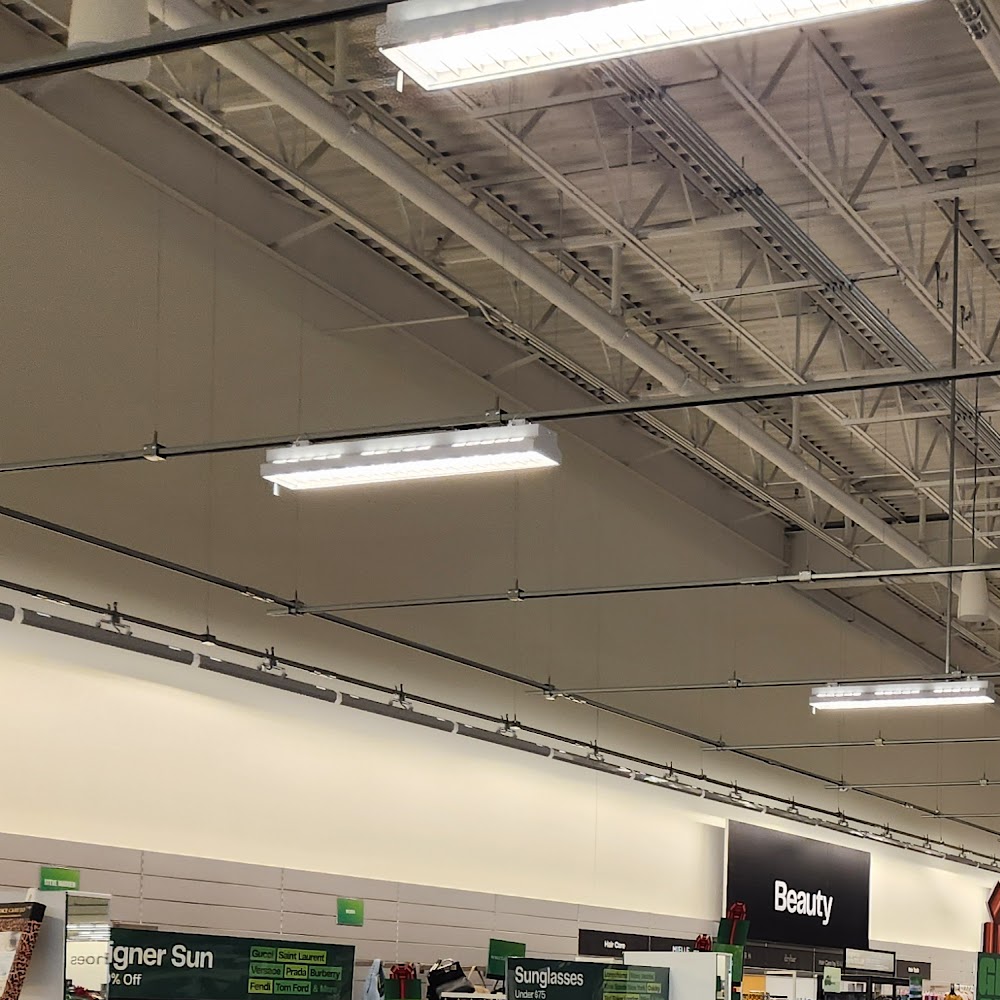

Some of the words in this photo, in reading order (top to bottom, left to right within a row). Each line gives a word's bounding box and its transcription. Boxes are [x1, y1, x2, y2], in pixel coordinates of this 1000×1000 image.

[774, 879, 833, 925] Beauty
[171, 944, 213, 968] Sun
[252, 950, 274, 958] Gucci
[279, 952, 297, 960] Saint
[299, 953, 325, 962] Laurent
[251, 966, 280, 976] Versace
[286, 968, 306, 977] Prada
[310, 970, 340, 980] Burberry
[123, 974, 142, 985] Off
[515, 966, 584, 988] Sunglasses
[250, 982, 270, 991] Fendi
[276, 983, 291, 991] Tom
[293, 984, 309, 992] Ford
[514, 990, 533, 999] Under
[535, 991, 546, 999] $75
